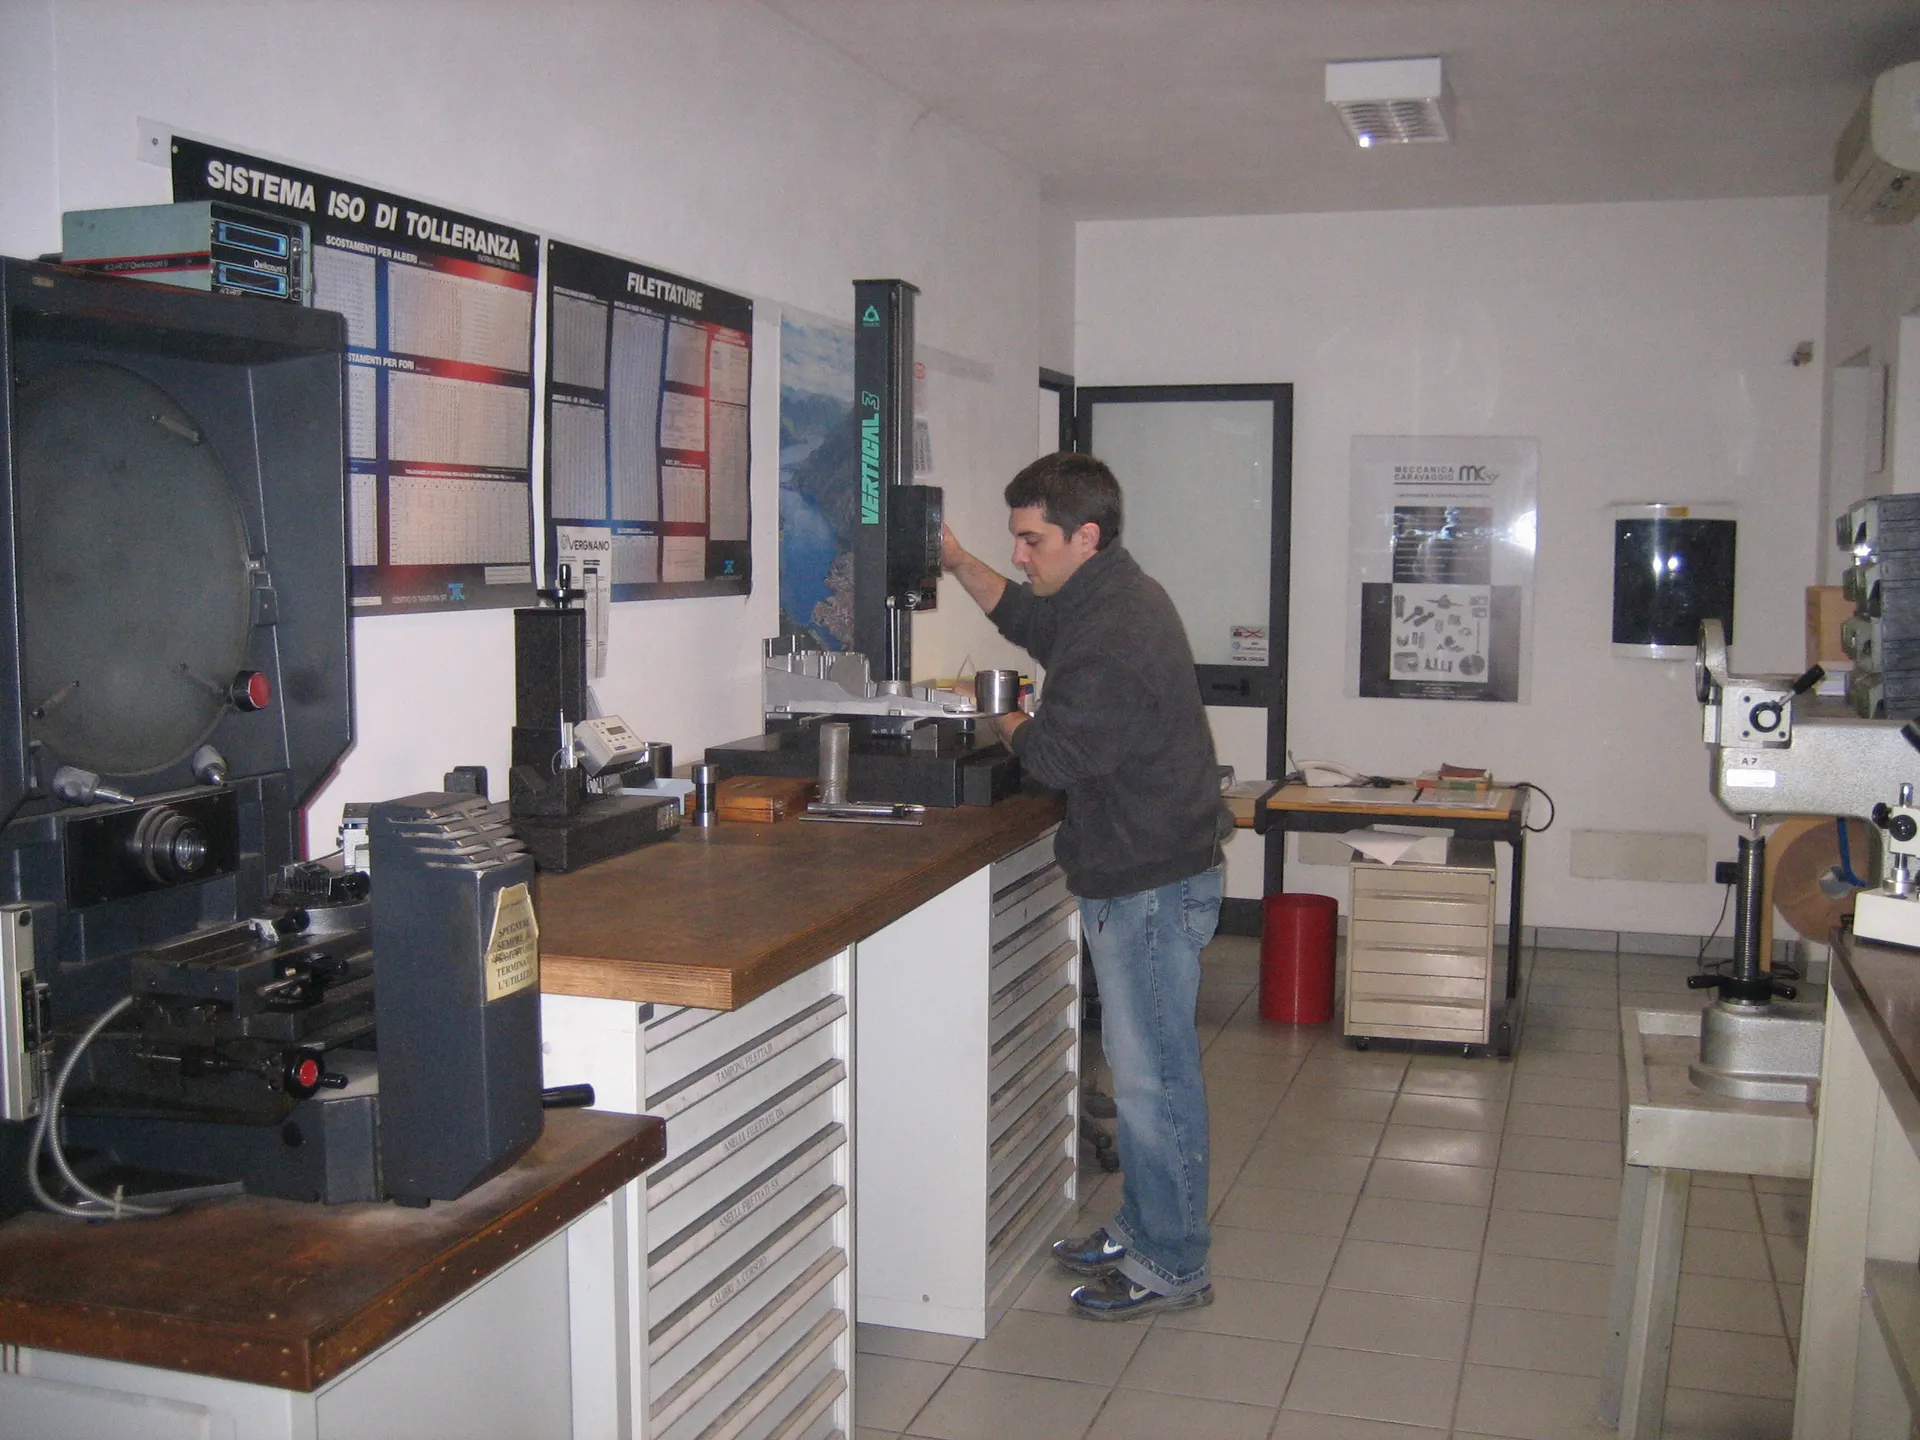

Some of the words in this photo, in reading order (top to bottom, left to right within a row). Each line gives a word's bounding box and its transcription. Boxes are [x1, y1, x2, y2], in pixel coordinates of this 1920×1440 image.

[207, 160, 316, 212] SISTEMA
[327, 190, 366, 223] ISO
[375, 203, 398, 230] DI
[406, 210, 520, 262] TOLLERANZA
[325, 235, 376, 255] SCOSTAMENTI
[377, 246, 392, 258] PER
[393, 250, 418, 264] ALBERI
[627, 271, 704, 310] FILETTATURE
[347, 353, 382, 366] STAMENTI
[382, 356, 397, 368] PER
[398, 359, 415, 371] FORI
[862, 391, 880, 410] 3
[861, 413, 880, 524] VERTICAL
[568, 539, 610, 551] VERGNANO
